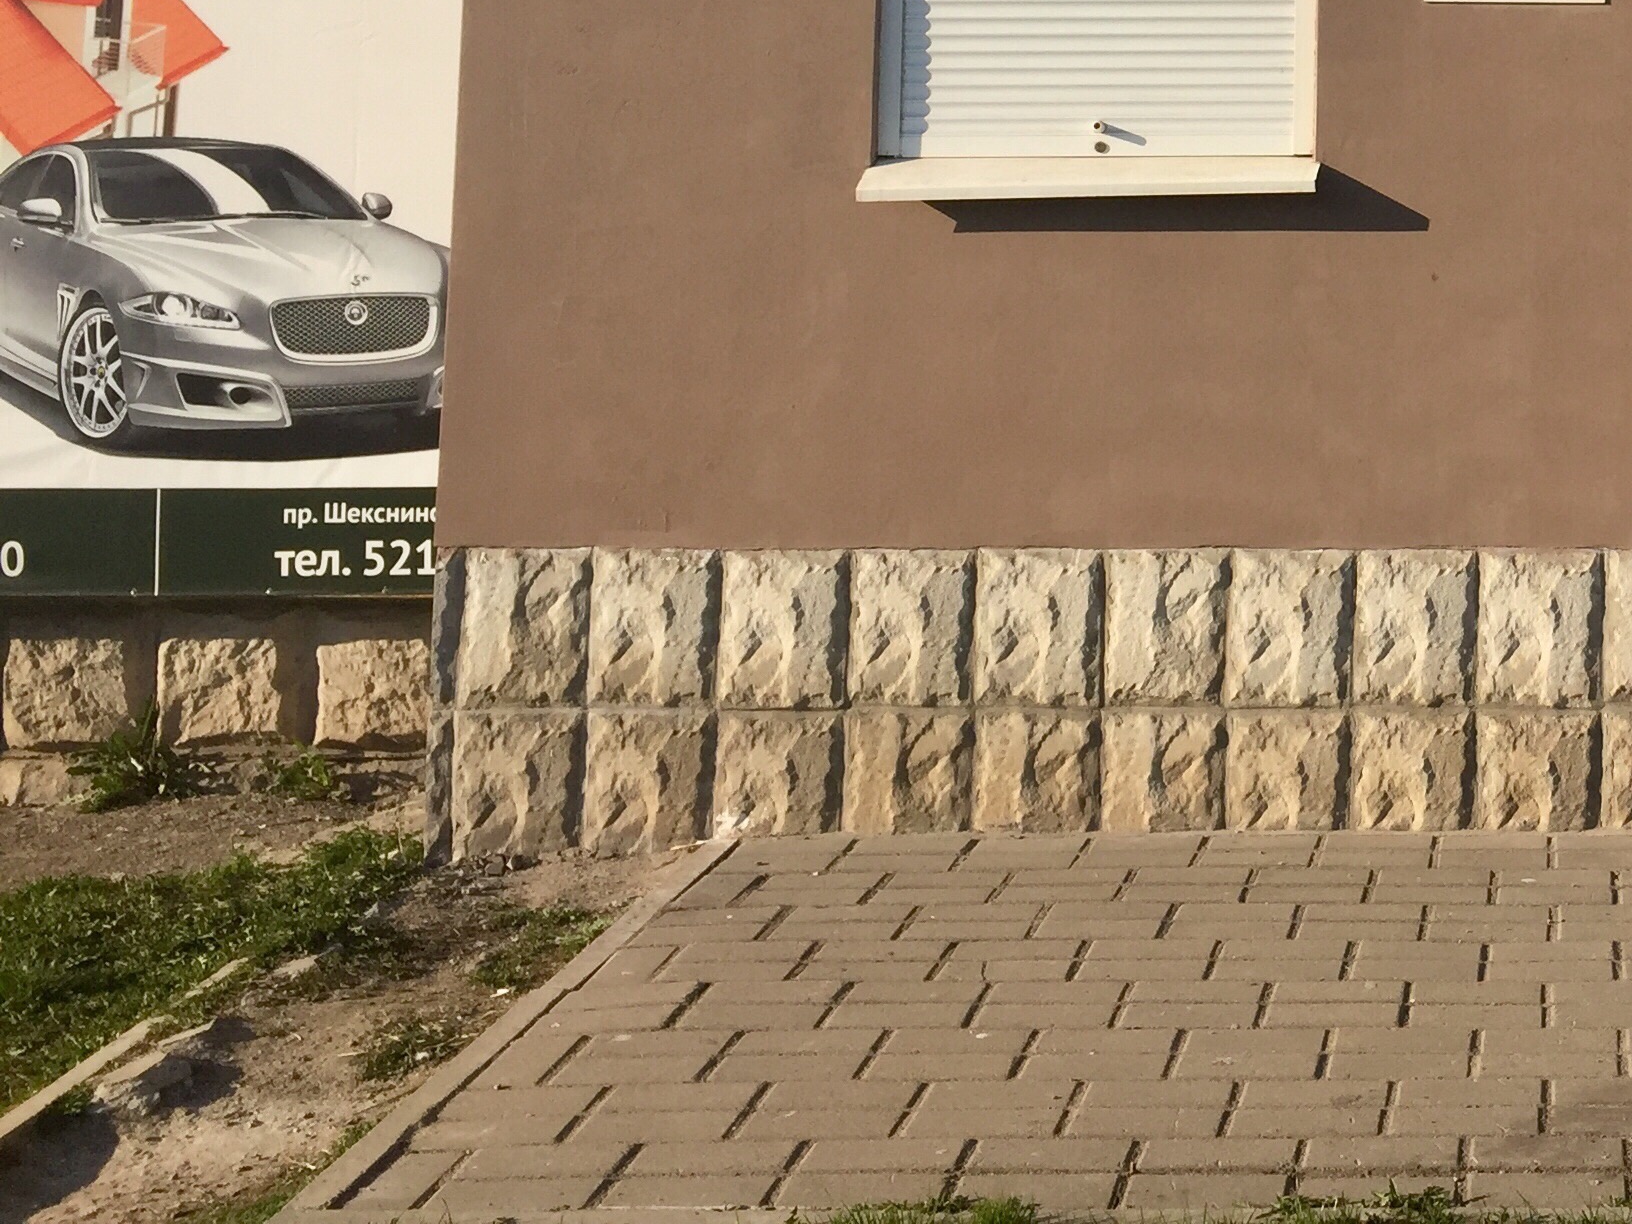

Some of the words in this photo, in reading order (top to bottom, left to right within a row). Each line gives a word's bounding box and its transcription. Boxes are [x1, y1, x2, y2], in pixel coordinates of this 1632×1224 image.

[283, 507, 318, 529] пр.
[274, 549, 351, 576] тел.
[363, 539, 436, 576] 521
